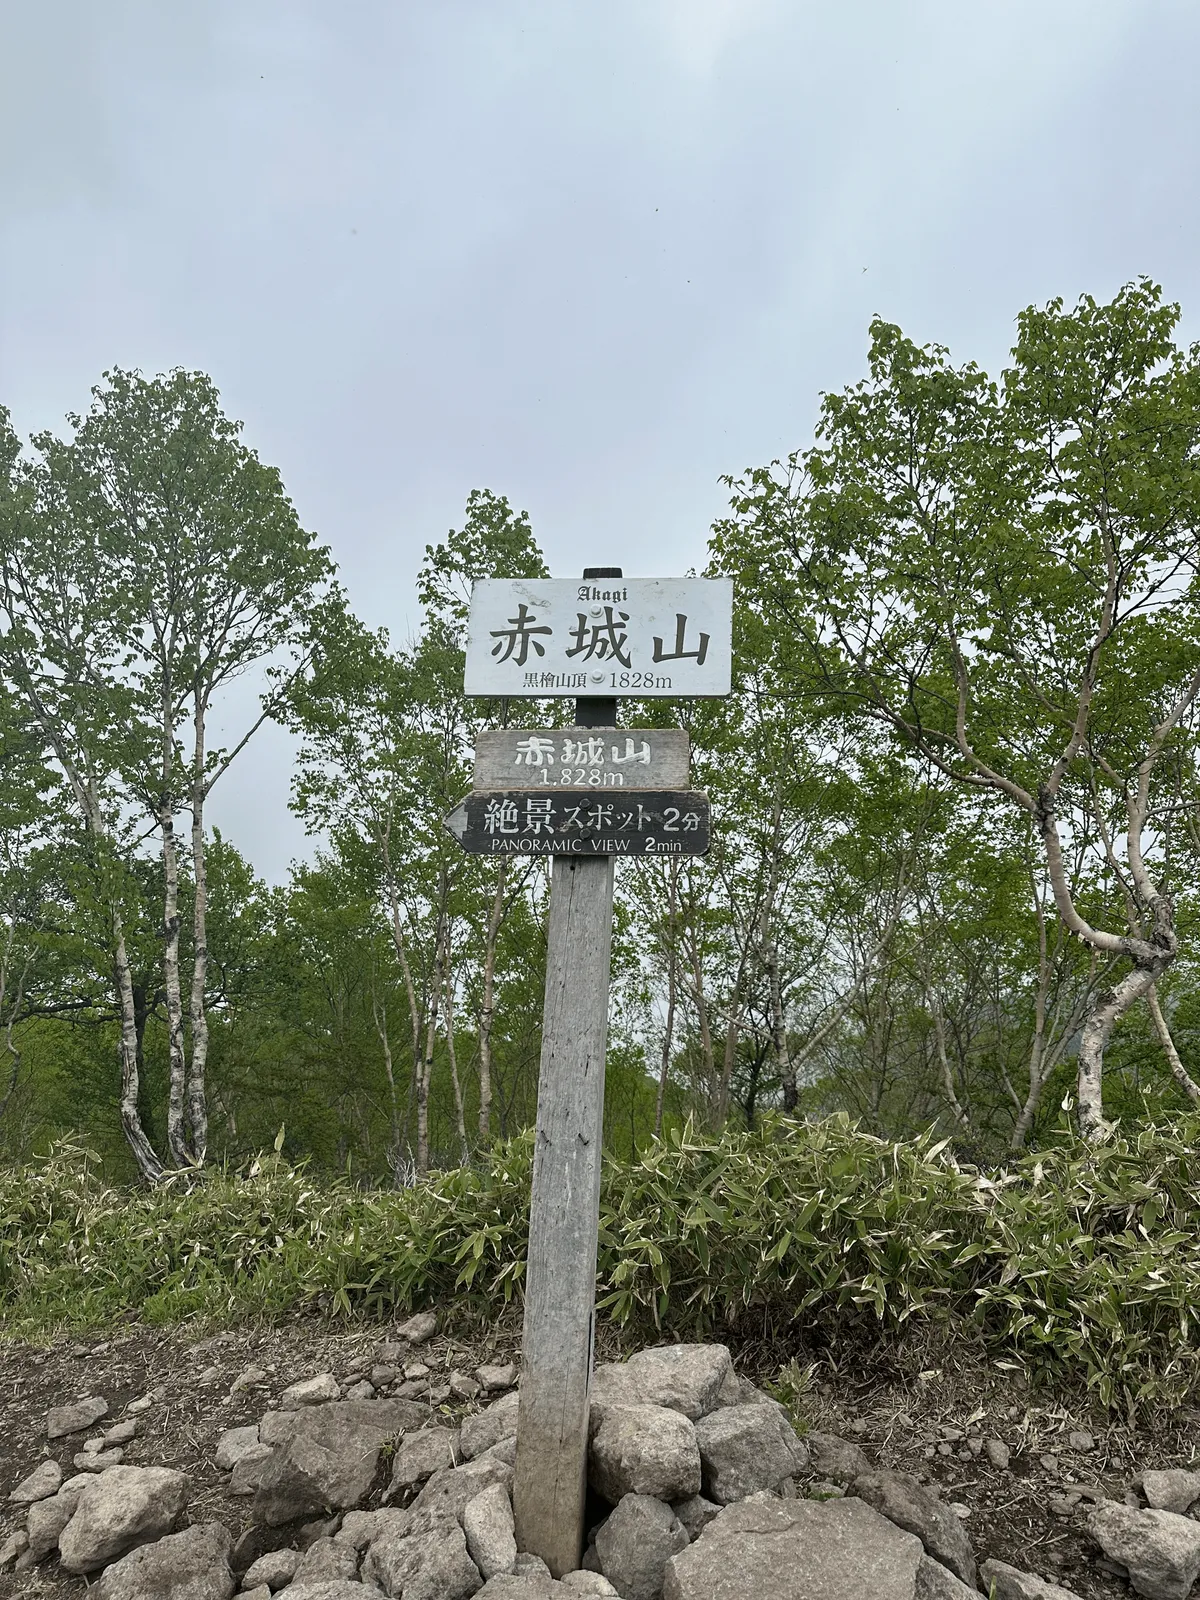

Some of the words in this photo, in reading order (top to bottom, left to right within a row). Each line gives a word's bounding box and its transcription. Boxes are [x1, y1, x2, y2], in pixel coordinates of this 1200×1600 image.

[577, 586, 628, 603] Akagi
[489, 603, 711, 669] 赤城山
[522, 672, 588, 688] 黒檜山頂
[609, 672, 672, 688] 1828m
[514, 736, 651, 766] 赤城山
[491, 838, 582, 852] PANORAMIC
[591, 839, 631, 852] VIEW
[645, 836, 682, 852] 2min
